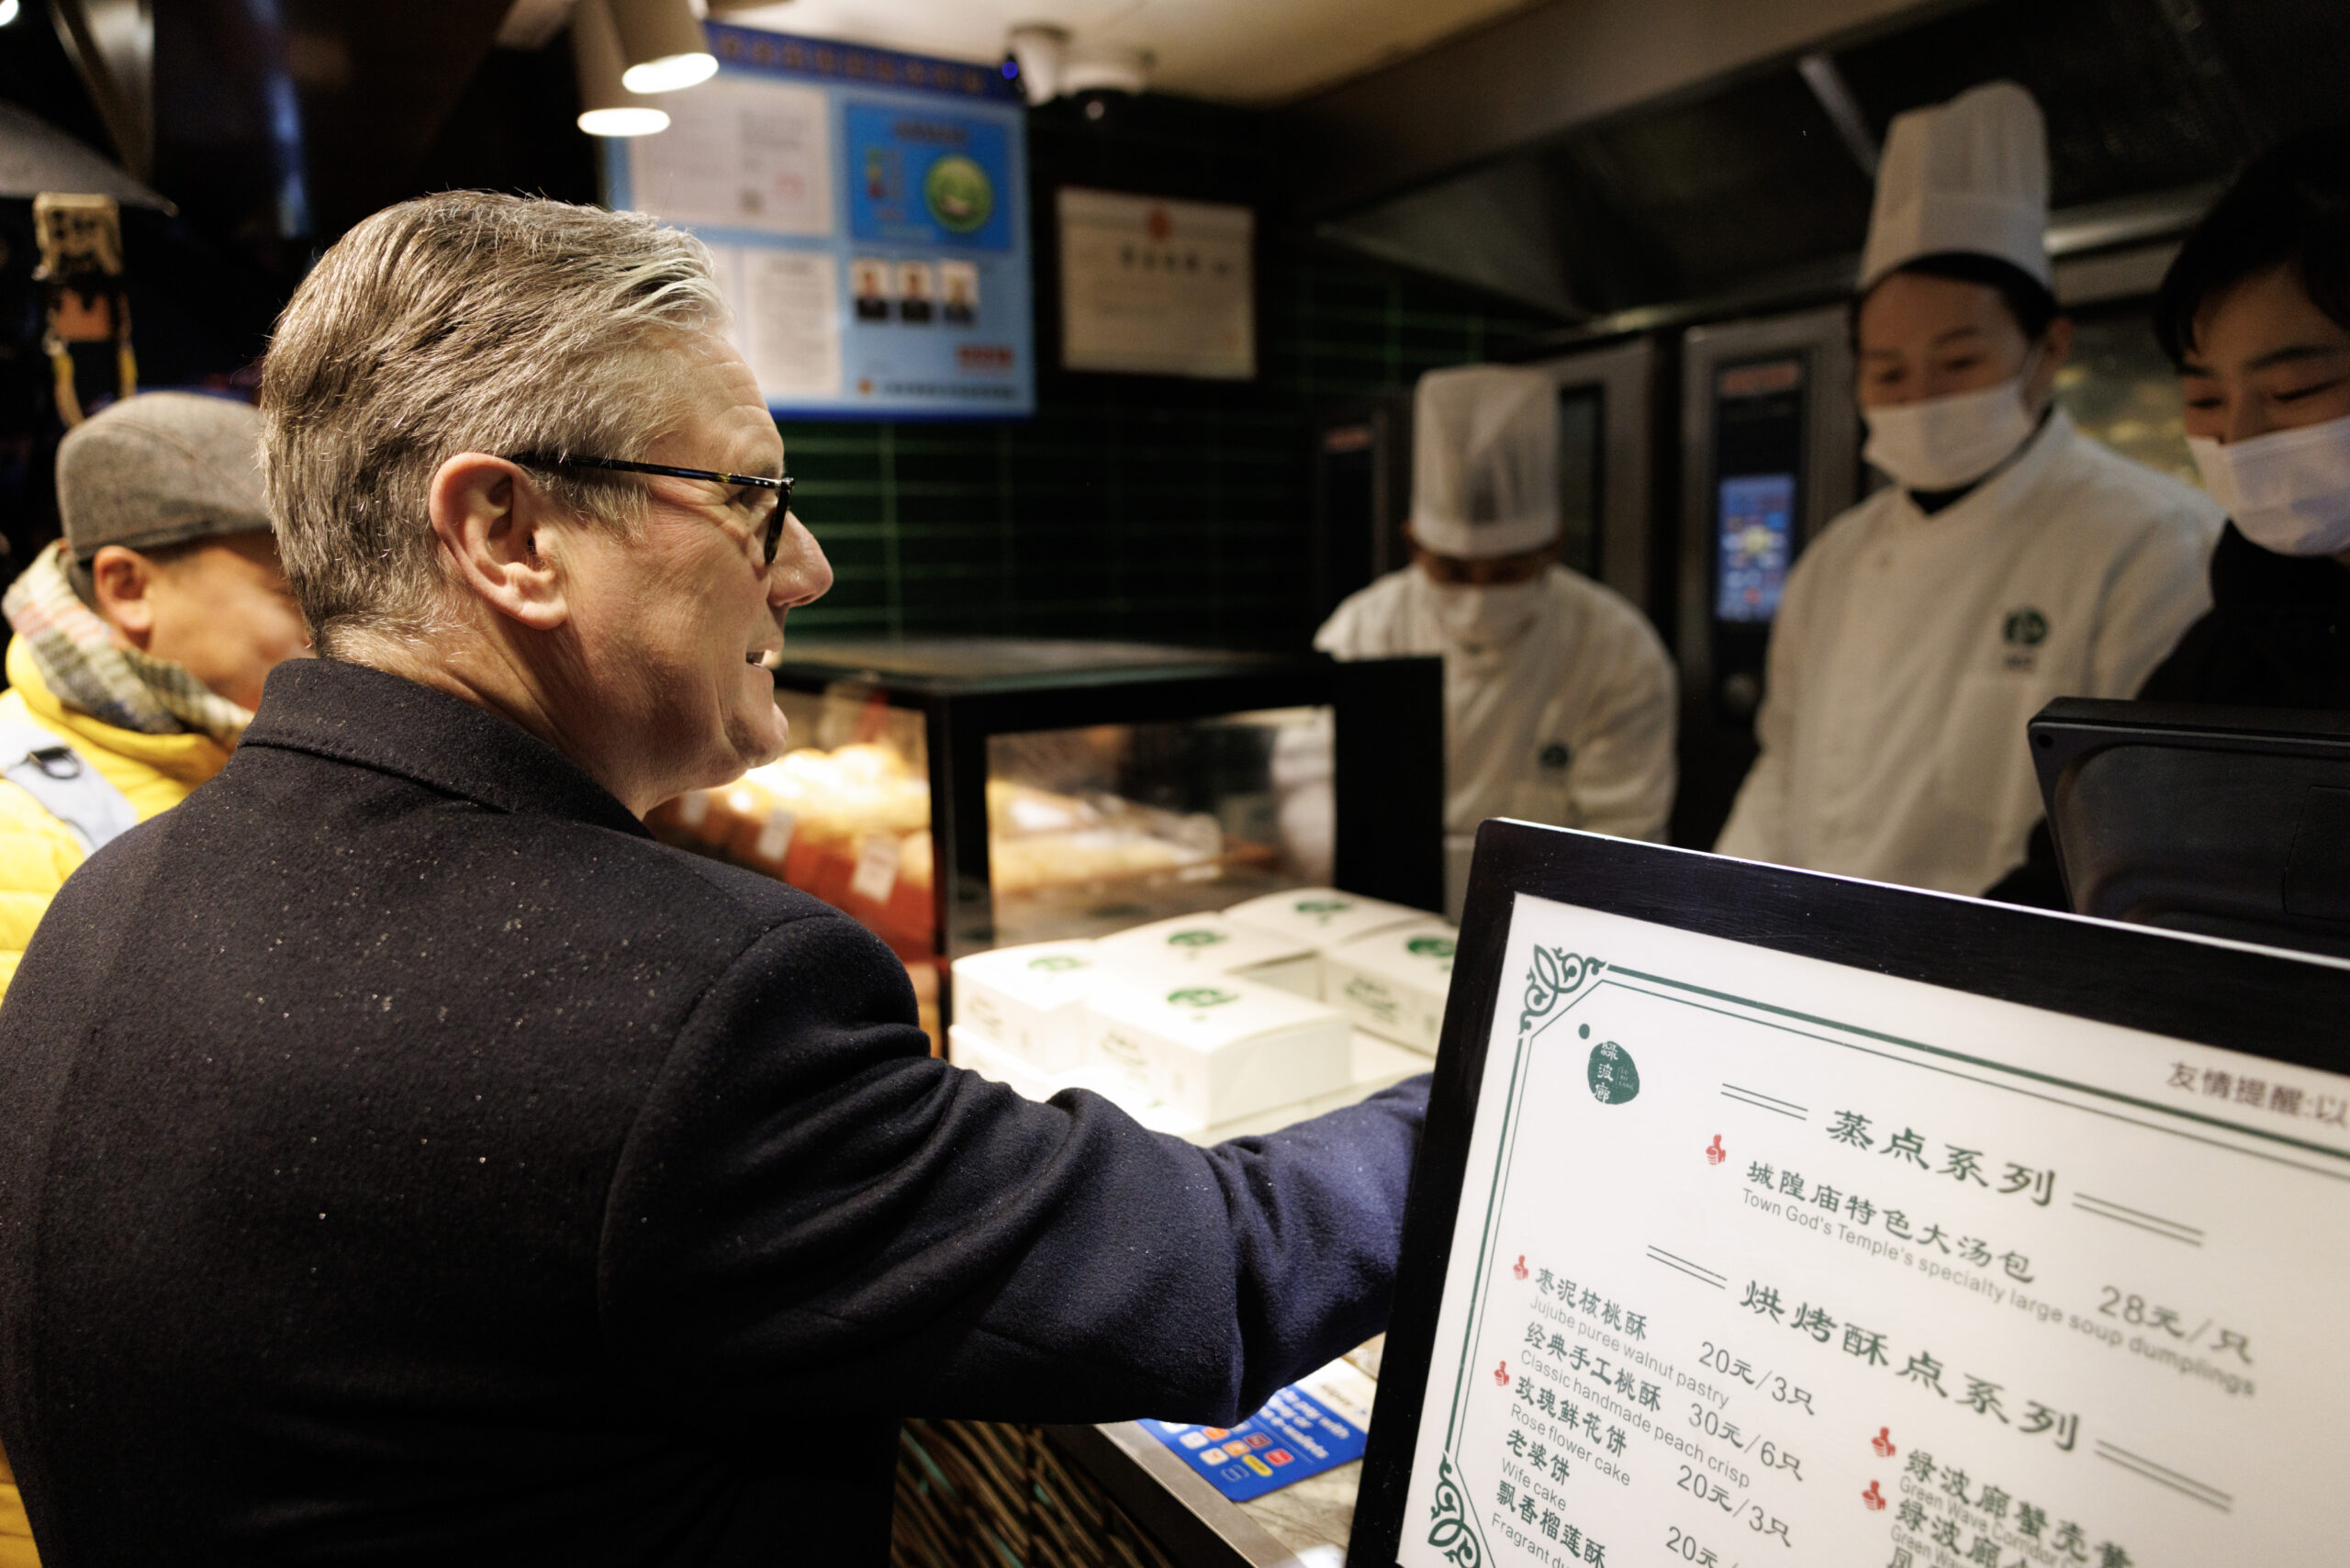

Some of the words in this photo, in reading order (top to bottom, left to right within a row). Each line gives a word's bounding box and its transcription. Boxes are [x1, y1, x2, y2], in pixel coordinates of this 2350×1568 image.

[1826, 1110, 2055, 1207] 蒸点系列
[1746, 1160, 2034, 1283] 城隍庙特色大汤包
[1536, 1268, 1648, 1341] 枣泥核桃酥
[1742, 1188, 1782, 1216] Town
[1785, 1204, 1833, 1236] God's
[1837, 1223, 1914, 1266] Temple's
[1917, 1256, 2006, 1305] specialty
[2009, 1289, 2064, 1323] large
[2067, 1315, 2123, 1349] soup
[2128, 1335, 2256, 1396] dumplings
[2097, 1284, 2254, 1365] 28元/只
[1523, 1321, 1662, 1412] 经典手工桃酥
[1529, 1295, 1575, 1328] Jujube
[1578, 1321, 1620, 1352] puree
[1623, 1343, 1674, 1381] walnut
[1675, 1372, 1730, 1410] pastry
[1698, 1341, 1815, 1417] 20元/3只
[1740, 1280, 2079, 1452] 烘烤酥点系列
[1510, 1403, 1546, 1436] Rose
[1549, 1425, 1593, 1462] flower
[1595, 1456, 1630, 1486] cake
[1515, 1376, 1628, 1457] 玫瑰鲜花饼
[1520, 1350, 1571, 1389] Classic
[1572, 1377, 1651, 1433] handmade
[1654, 1426, 1705, 1464] peach
[1707, 1454, 1751, 1489] crisp
[1688, 1403, 1804, 1482] 30元/6只
[1501, 1457, 1531, 1488] Wife
[1533, 1481, 1567, 1512] cake
[1506, 1429, 1571, 1486] 老婆饼
[1899, 1474, 1943, 1511] Green
[1491, 1512, 1550, 1565] Fragrant
[1496, 1480, 1606, 1568] 飘香榴莲酥
[1675, 1464, 1792, 1548] 20元/3只
[1890, 1524, 1931, 1559] Green
[1895, 1498, 2029, 1568] 绿波廊
[1665, 1526, 1739, 1568] 20元
